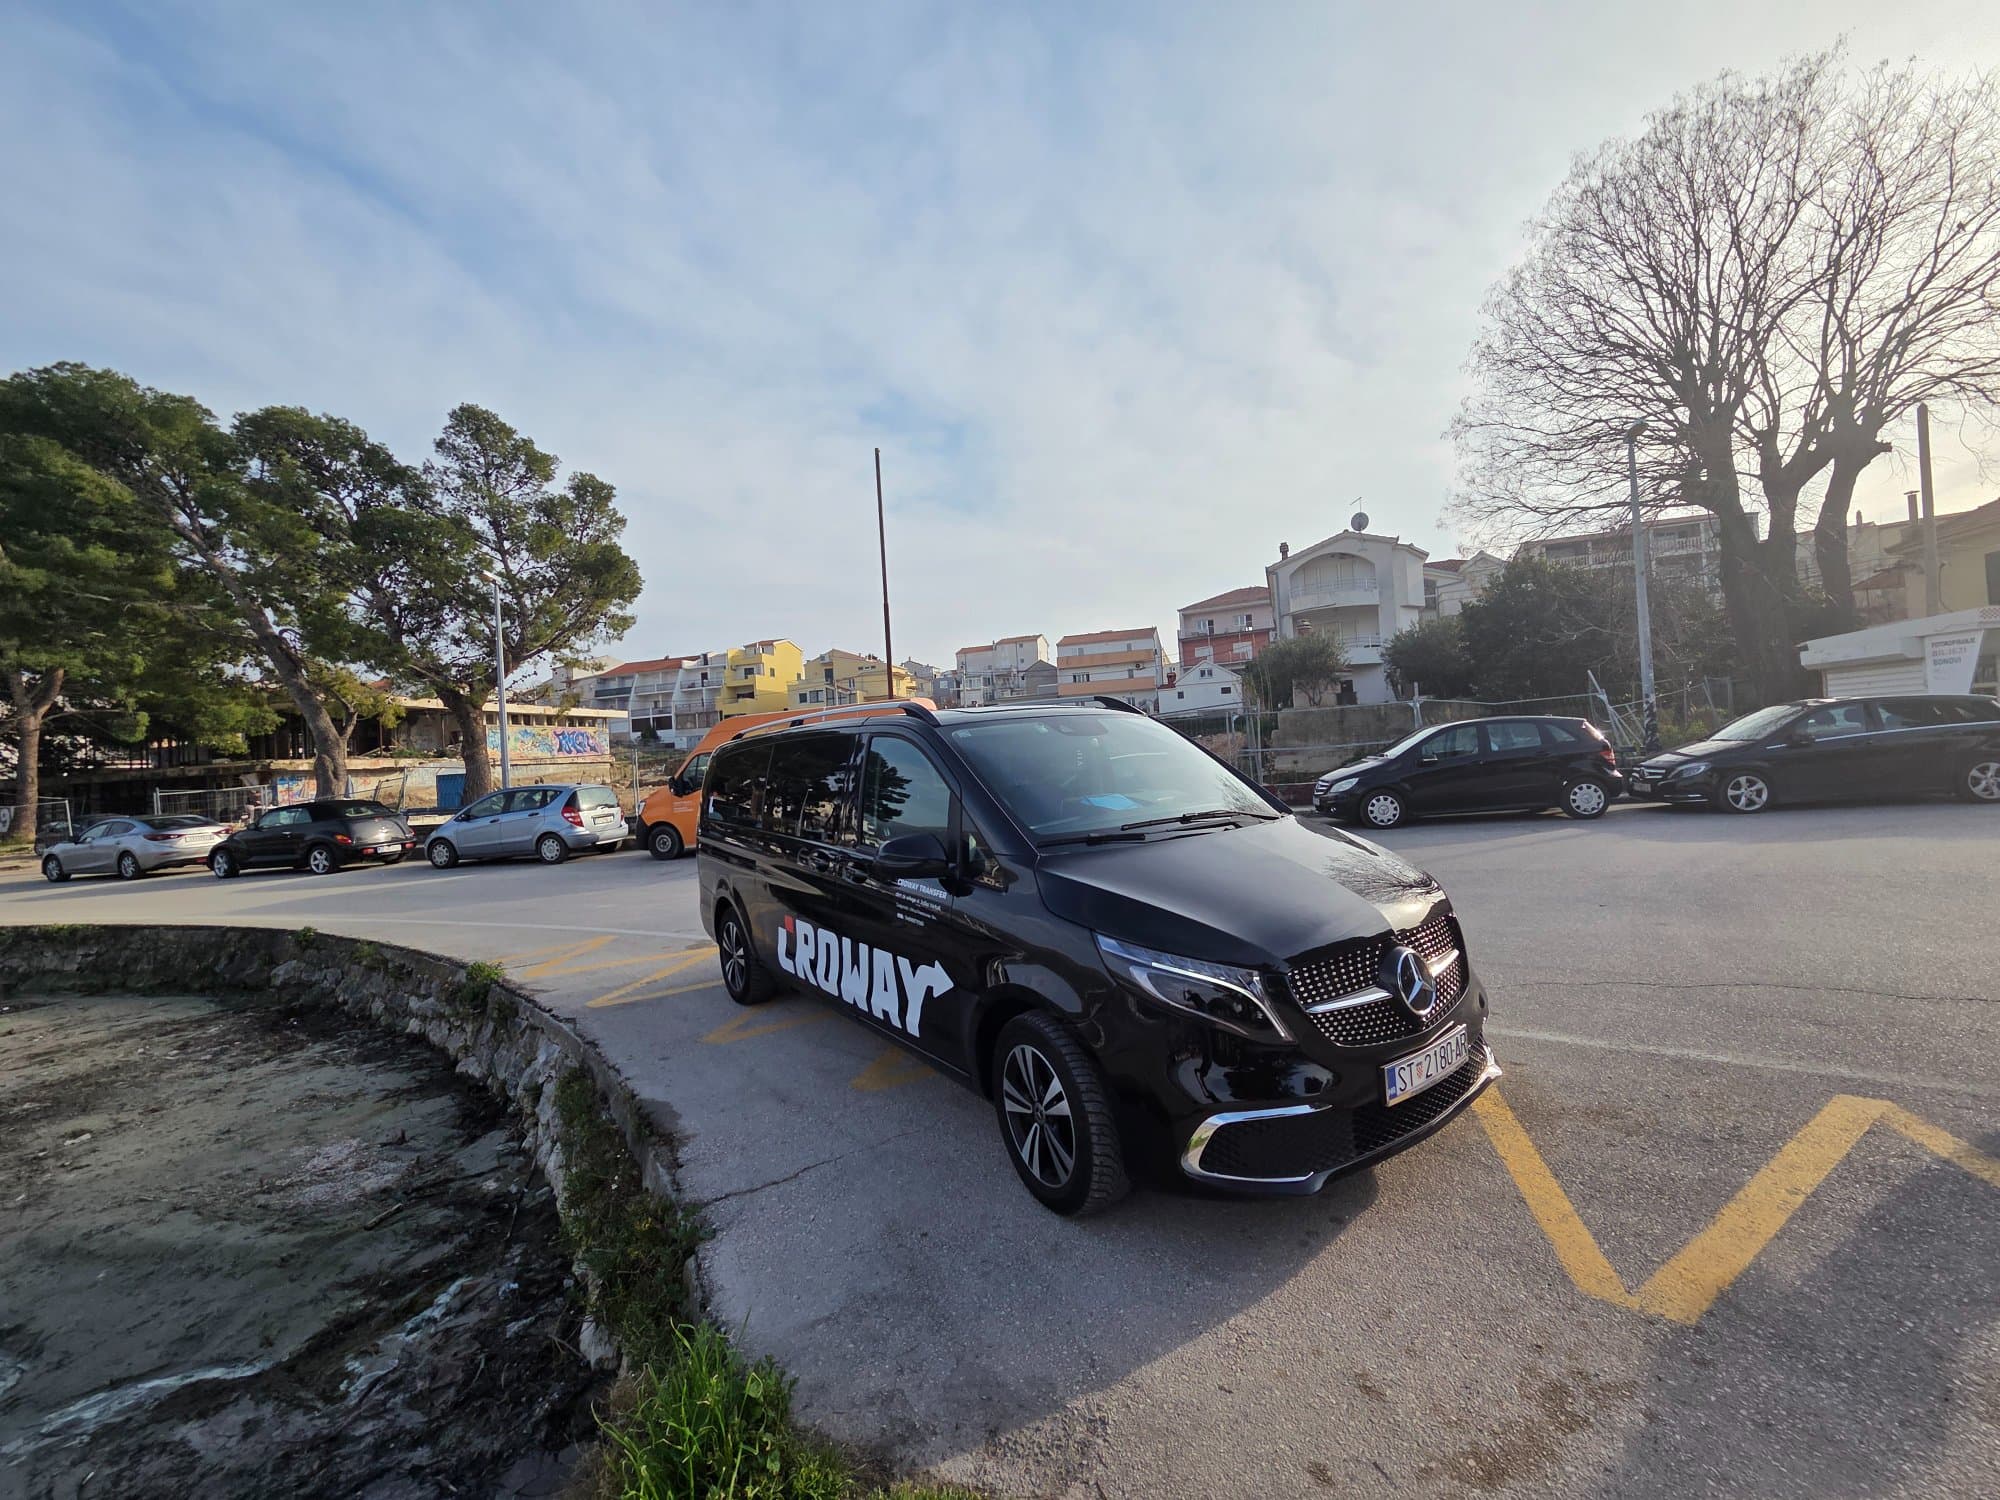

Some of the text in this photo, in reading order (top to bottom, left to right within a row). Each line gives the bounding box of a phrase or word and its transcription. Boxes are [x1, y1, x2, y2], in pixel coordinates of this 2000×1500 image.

[919, 884, 948, 900] TRANSFER
[777, 915, 954, 1038] CROWAY
[1398, 1032, 1467, 1092] ST 2180-AR
